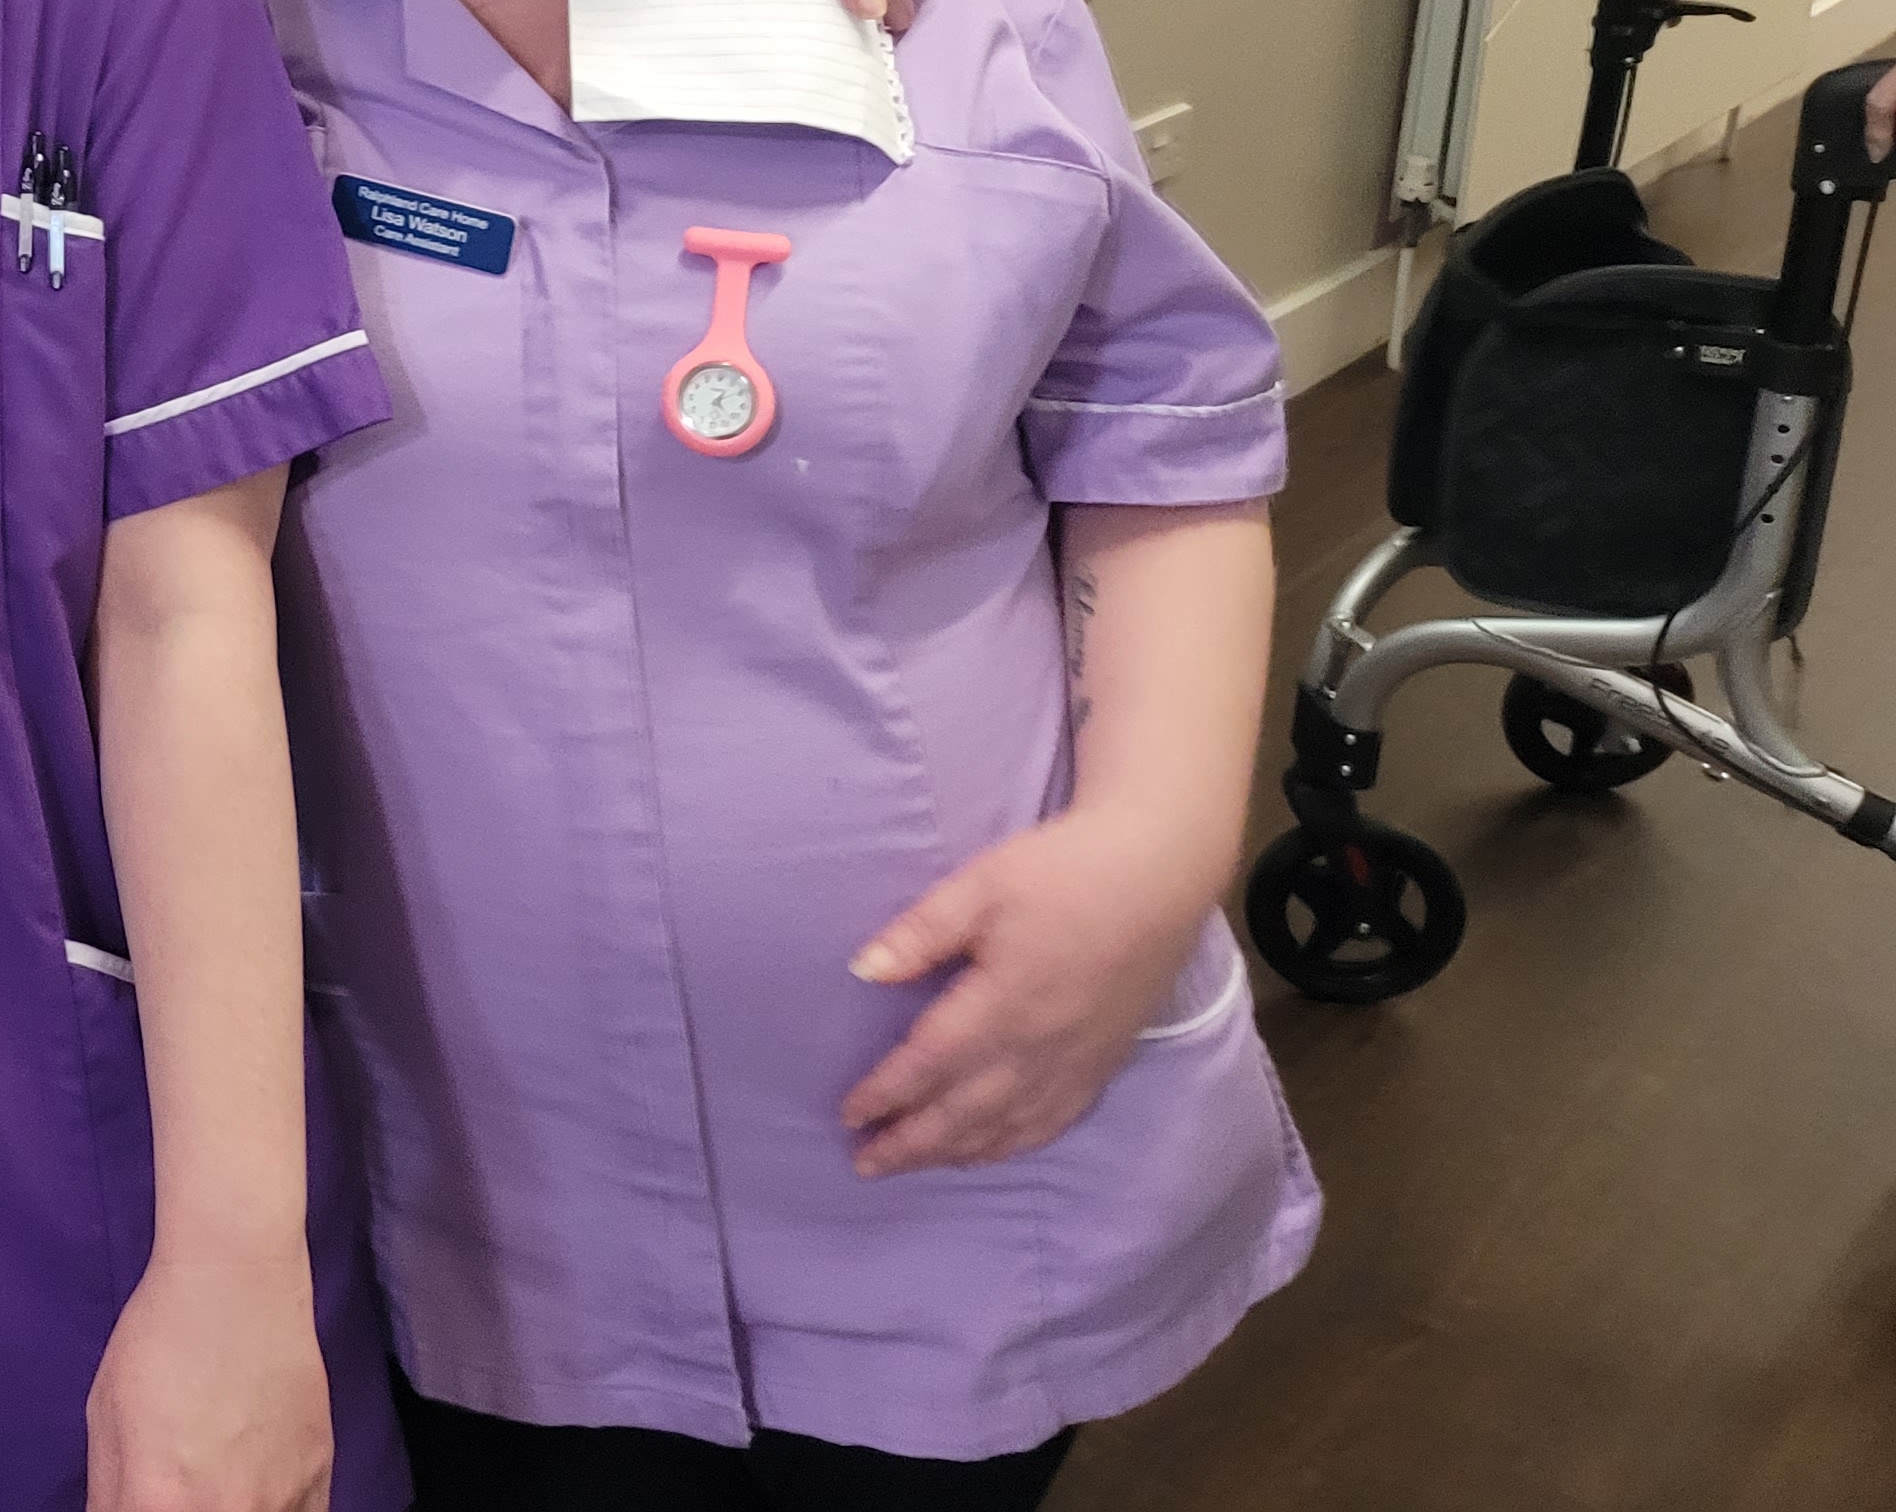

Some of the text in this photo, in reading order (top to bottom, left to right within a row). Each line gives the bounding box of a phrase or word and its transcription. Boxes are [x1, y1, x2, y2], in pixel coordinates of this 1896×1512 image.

[371, 205, 468, 243] Lisa Watson
[419, 202, 450, 220] Care
[451, 210, 490, 230] Home
